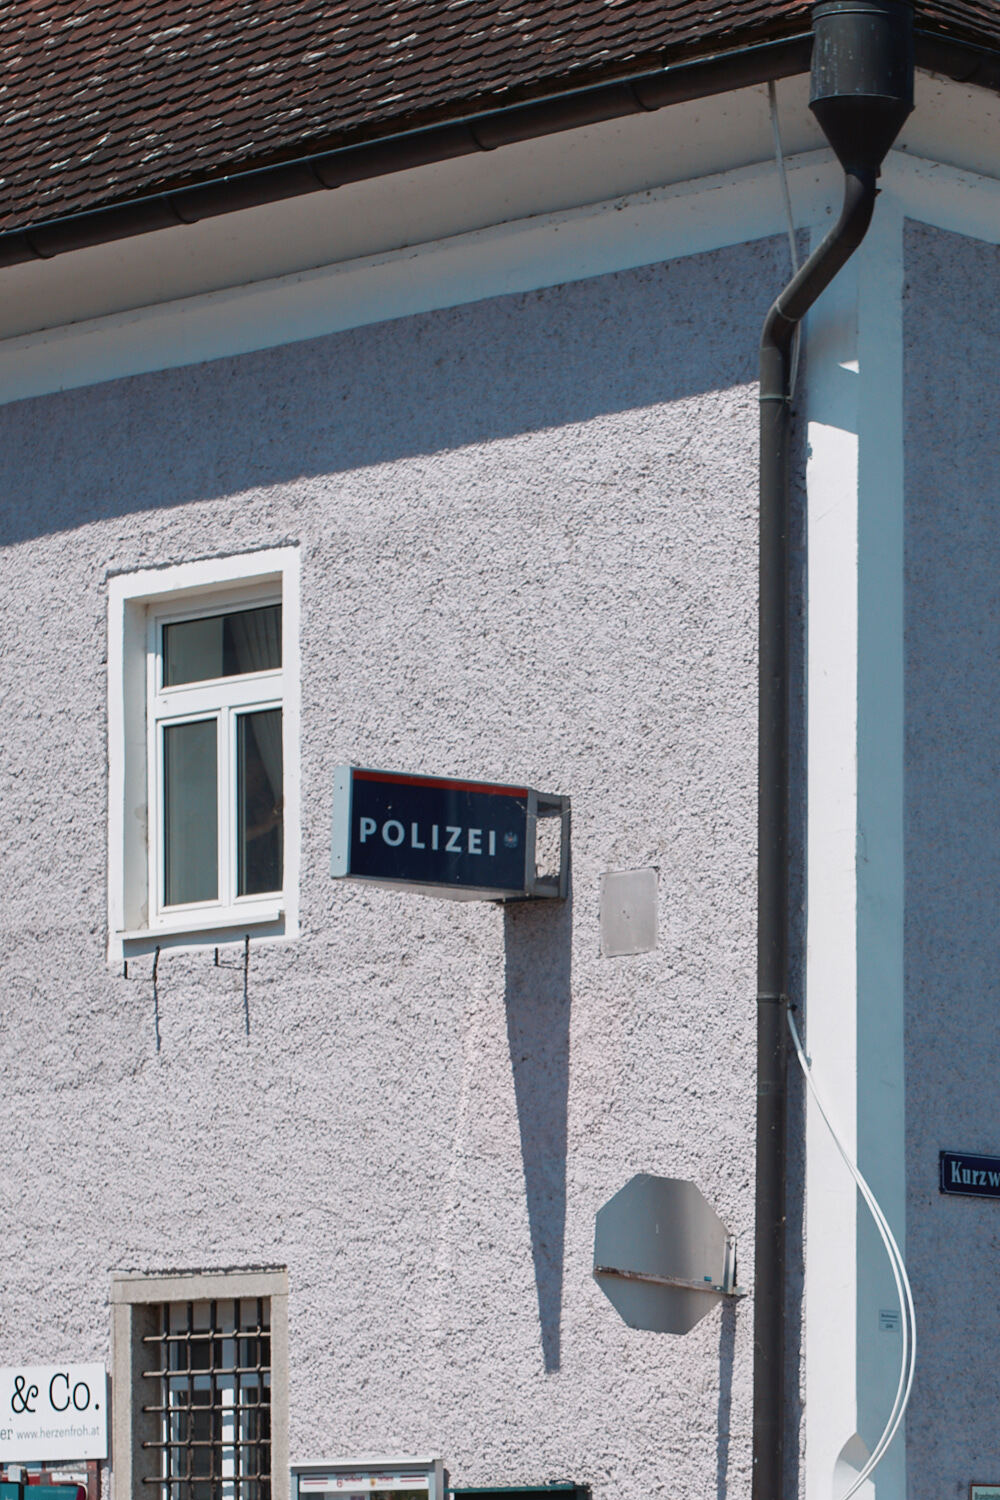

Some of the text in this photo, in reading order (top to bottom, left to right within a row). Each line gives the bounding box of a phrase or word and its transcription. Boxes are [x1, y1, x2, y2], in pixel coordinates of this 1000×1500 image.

[358, 816, 496, 857] POLIZEI
[11, 1372, 100, 1414] & Co.
[16, 1424, 100, 1439] www.herzenfroh.at
